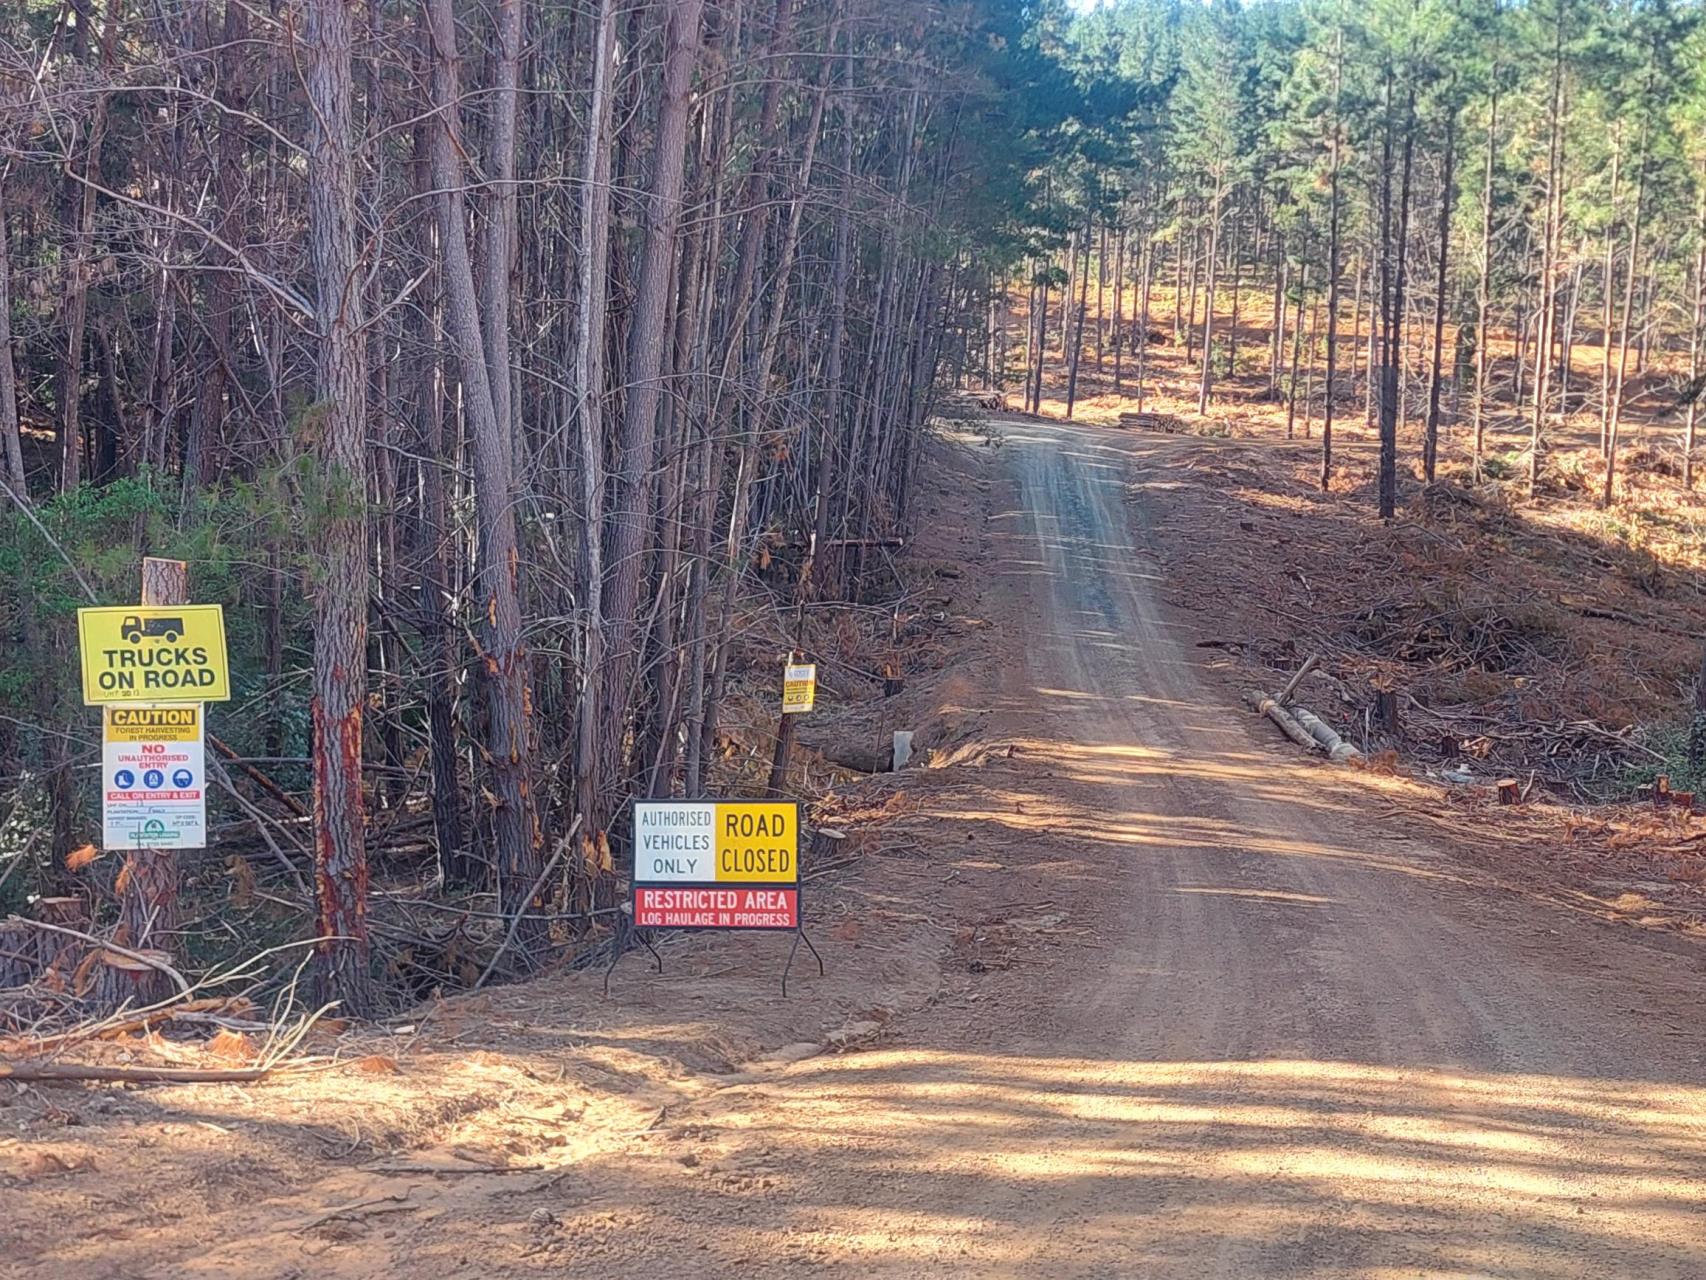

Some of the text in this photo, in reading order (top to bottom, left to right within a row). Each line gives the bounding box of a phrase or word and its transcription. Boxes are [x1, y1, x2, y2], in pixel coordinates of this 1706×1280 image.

[102, 647, 208, 668] TRUCKS
[98, 668, 215, 689] ON ROAD
[114, 710, 192, 724] CAUTION
[145, 726, 191, 734] HARVESTING
[141, 744, 165, 753] NO
[117, 754, 189, 762] UNAUTHORISED
[110, 792, 131, 800] CALL
[145, 791, 171, 799] ENTRY
[179, 791, 198, 799] EXIT
[642, 811, 711, 826] AUTHORISED
[726, 814, 785, 837] ROAD
[643, 835, 710, 850] VEHICLES
[653, 859, 698, 873] ONLY
[722, 849, 790, 872] CLOSED
[644, 891, 788, 909] RESTRICTED AREA
[641, 913, 790, 926] LOG HAULAGE IN PROGRESS
